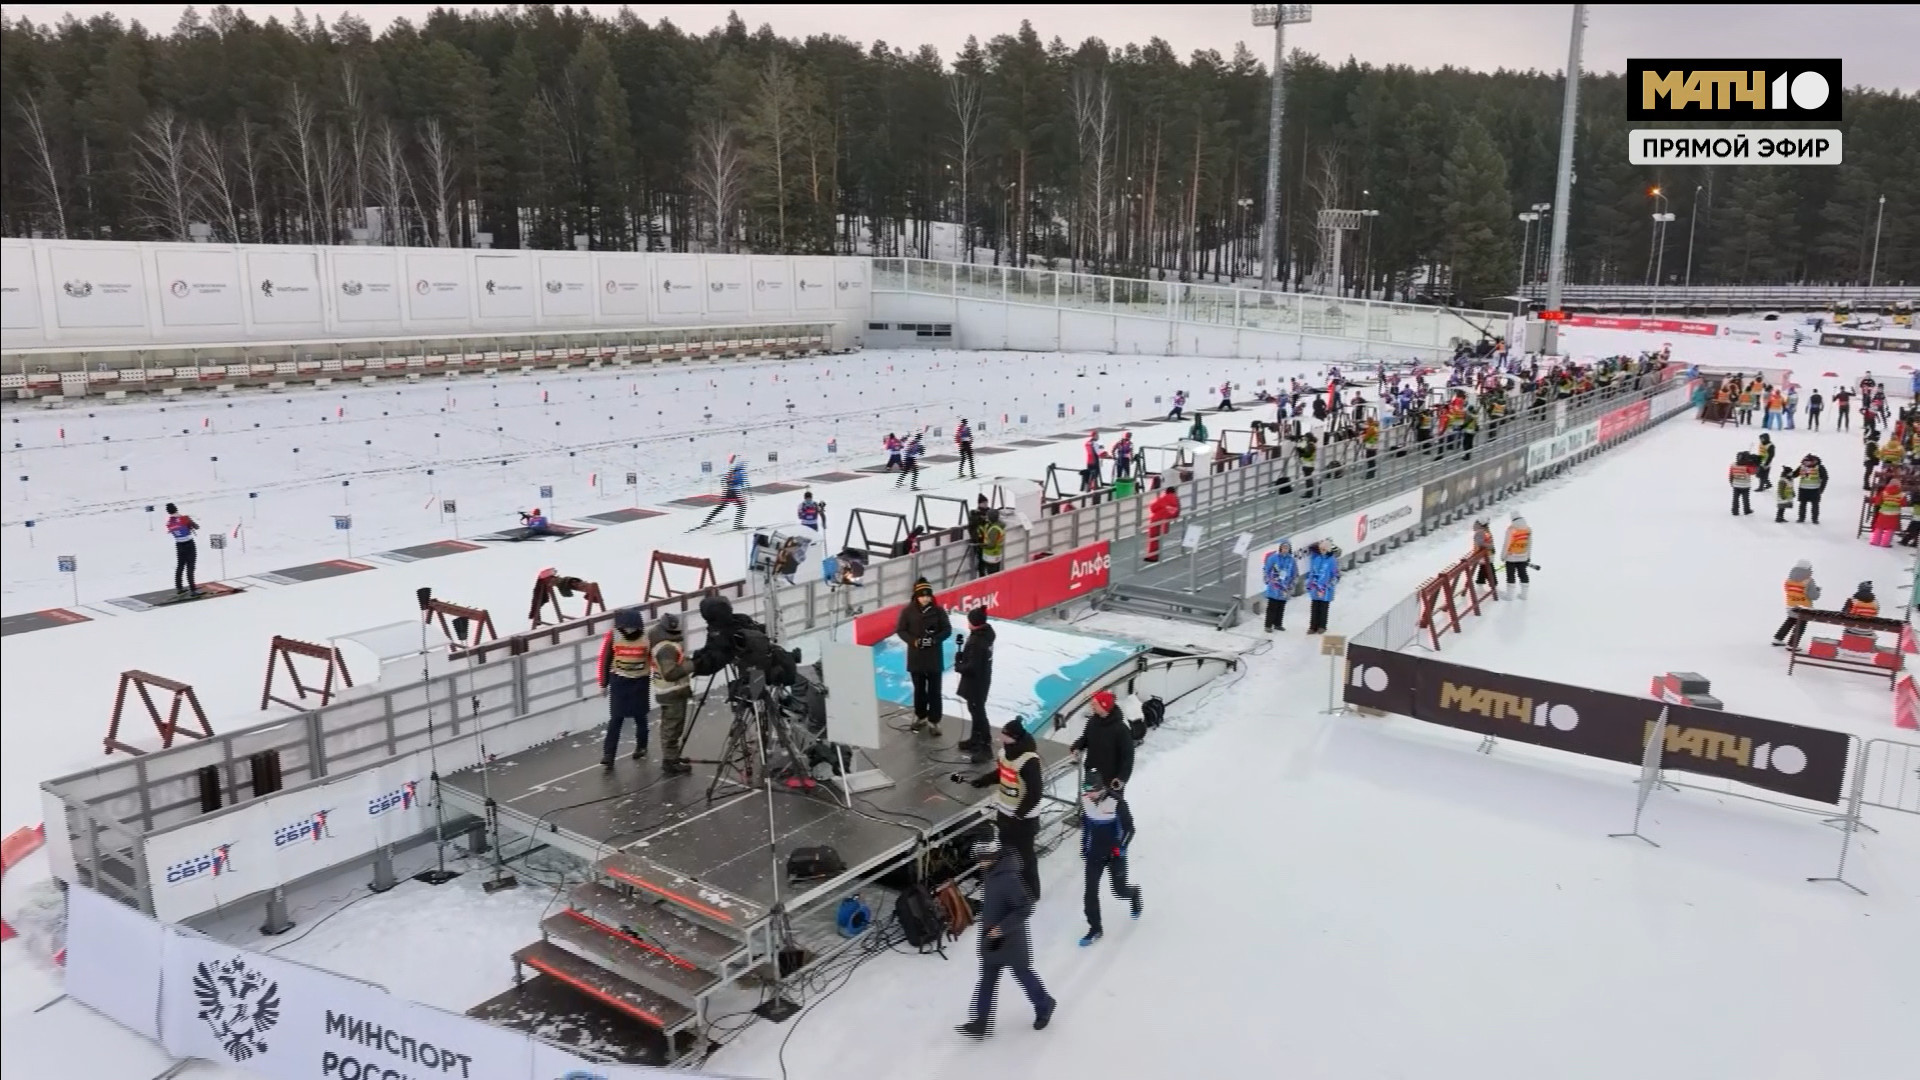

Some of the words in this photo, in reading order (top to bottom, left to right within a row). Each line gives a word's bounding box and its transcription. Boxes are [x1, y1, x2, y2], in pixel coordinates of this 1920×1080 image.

[36, 364, 48, 375] 22
[1070, 552, 1112, 581] Альфа
[368, 793, 402, 815] СБР
[274, 823, 311, 847] СБР
[166, 861, 212, 883] СБР
[324, 1008, 473, 1079] МИНСПОРТ
